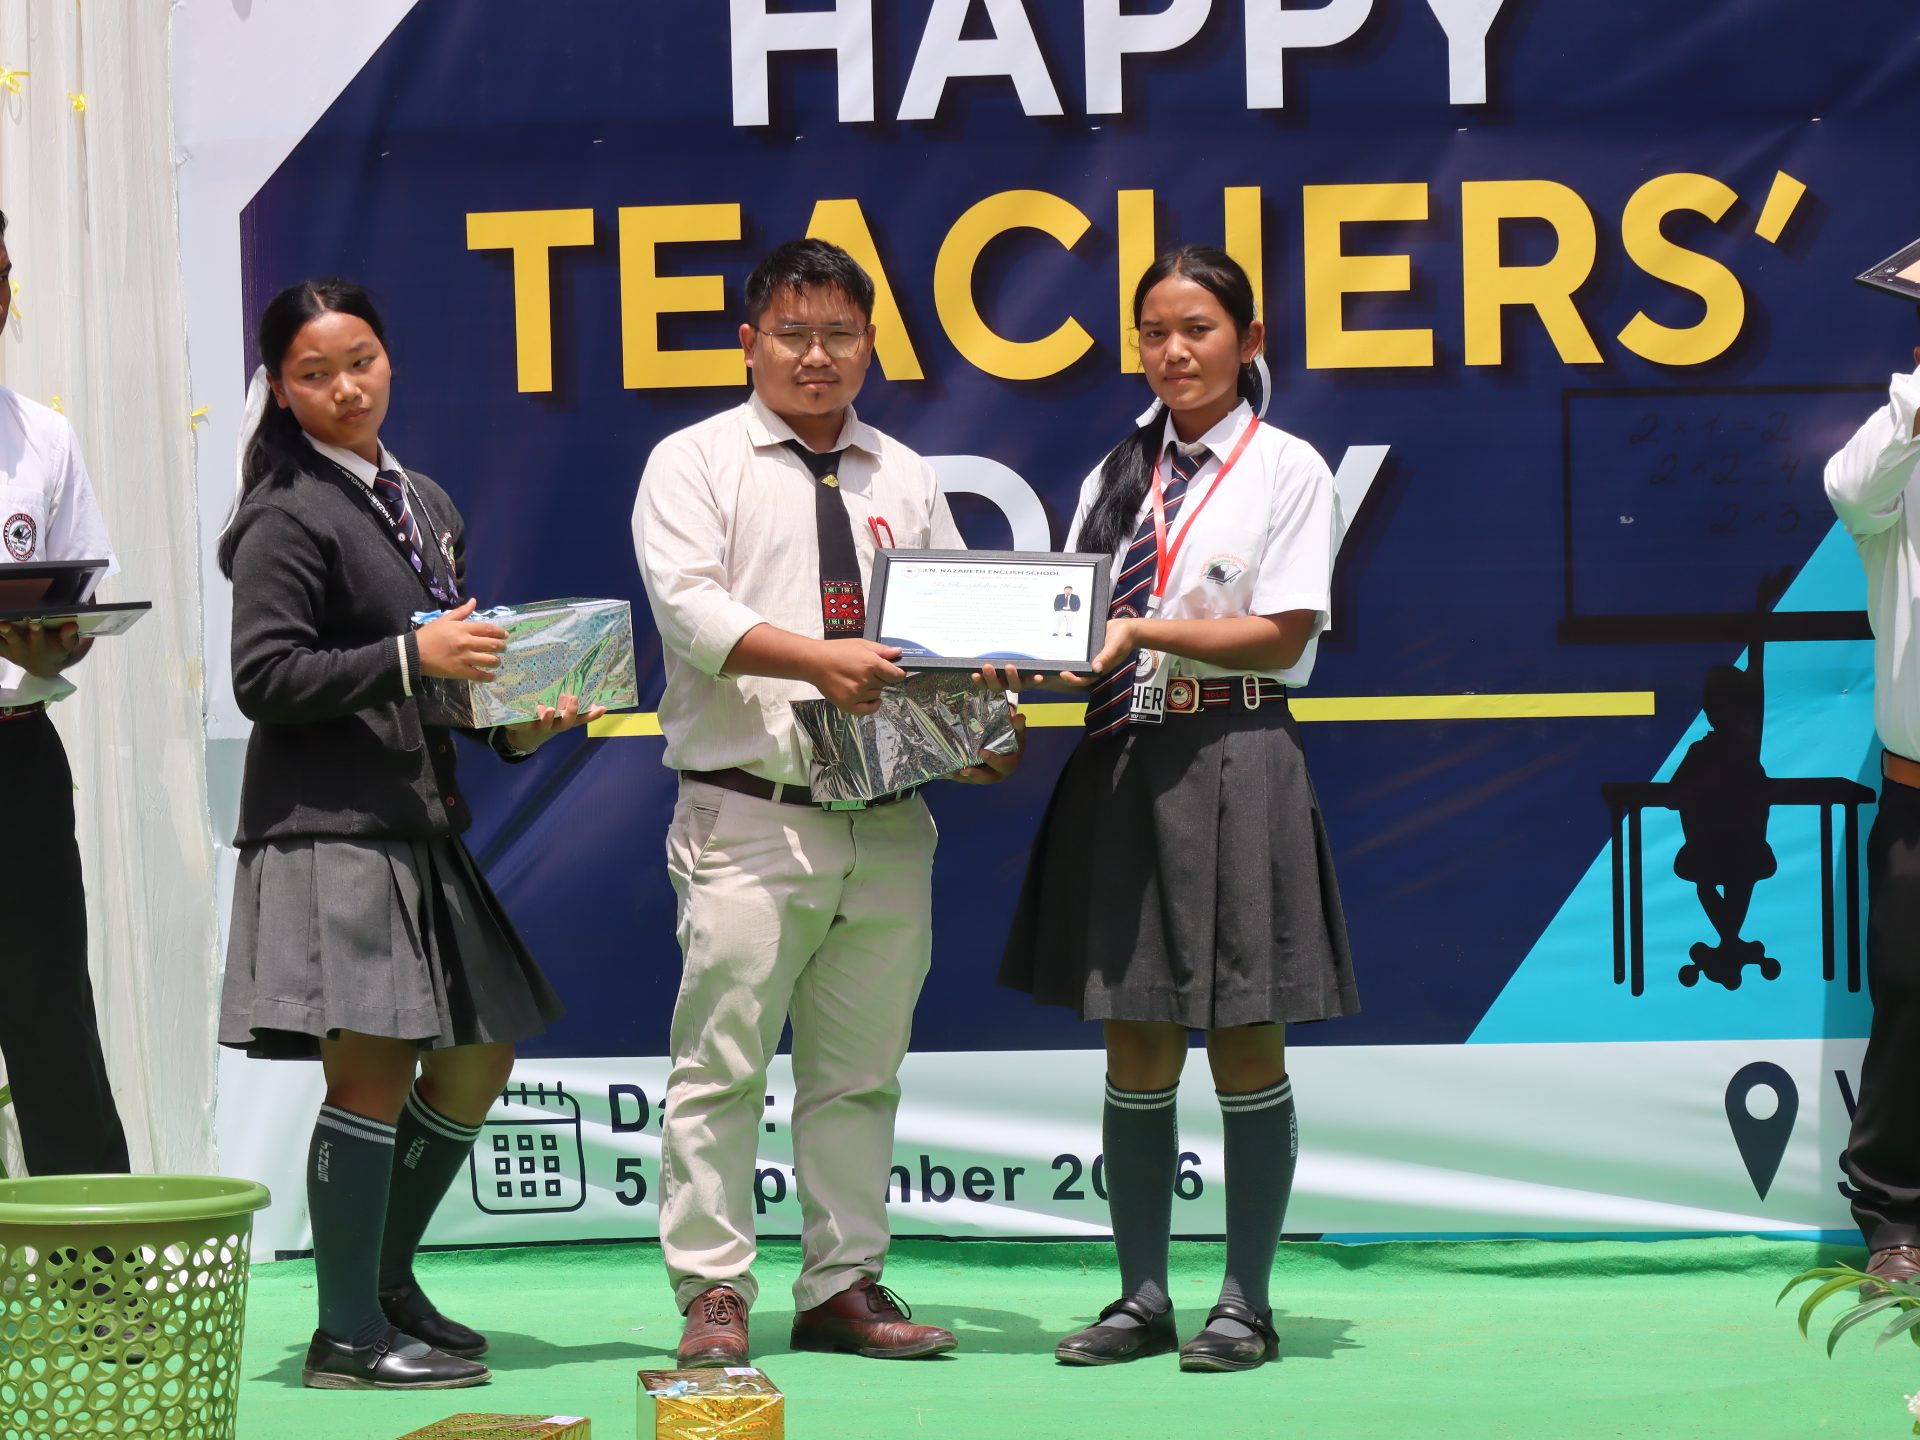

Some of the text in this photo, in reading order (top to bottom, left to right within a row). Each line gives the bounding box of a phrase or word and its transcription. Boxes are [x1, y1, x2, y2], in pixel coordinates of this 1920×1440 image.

[730, 0, 1501, 126] HAPPY
[615, 1157, 647, 1206] 5
[1051, 1151, 1204, 1200] 26
